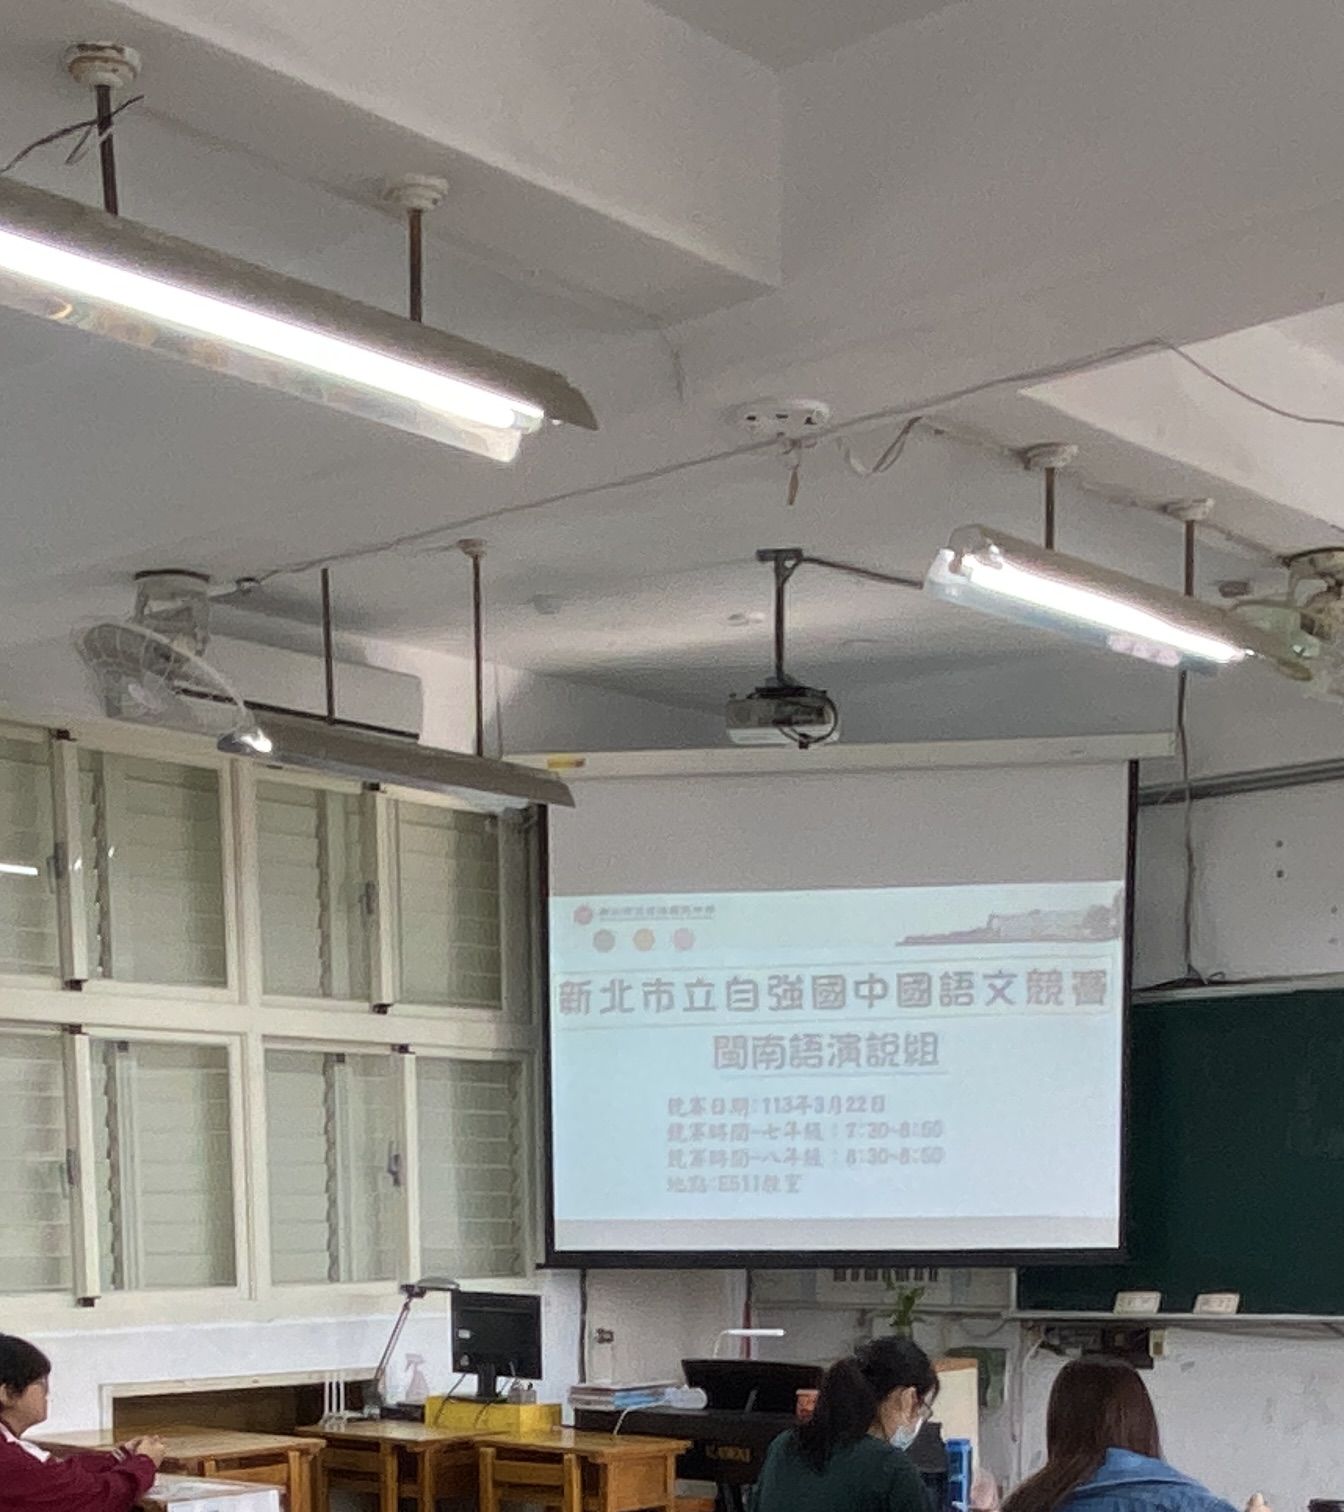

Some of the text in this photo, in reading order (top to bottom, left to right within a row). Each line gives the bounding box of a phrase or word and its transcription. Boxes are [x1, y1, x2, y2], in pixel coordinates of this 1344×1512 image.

[558, 967, 1108, 1015] 新北市立自強國中國語文競賽
[712, 1031, 941, 1071] 閩南語演說組
